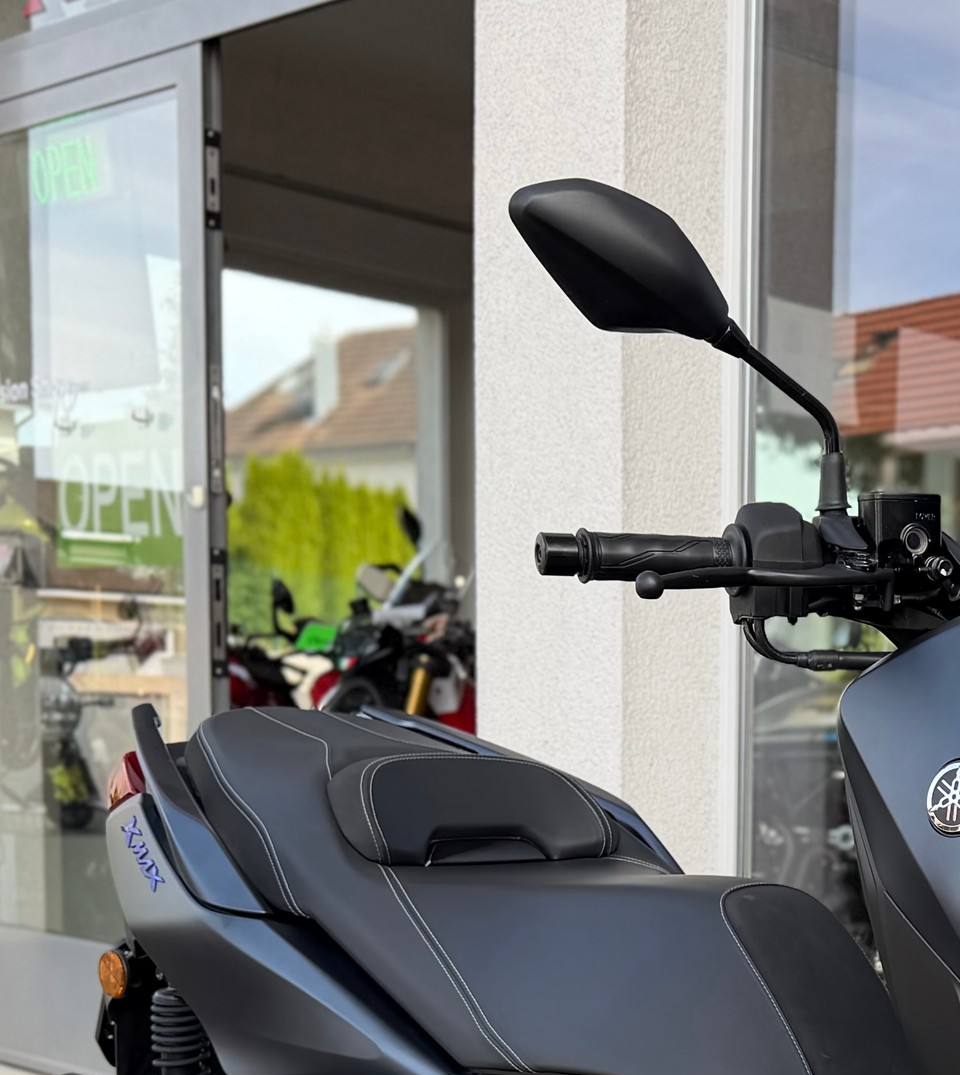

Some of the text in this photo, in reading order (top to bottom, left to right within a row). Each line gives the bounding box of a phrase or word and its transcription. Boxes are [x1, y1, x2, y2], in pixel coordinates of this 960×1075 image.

[32, 136, 97, 205] OPEN
[58, 450, 184, 538] OPEN
[120, 815, 166, 893] XMAX
